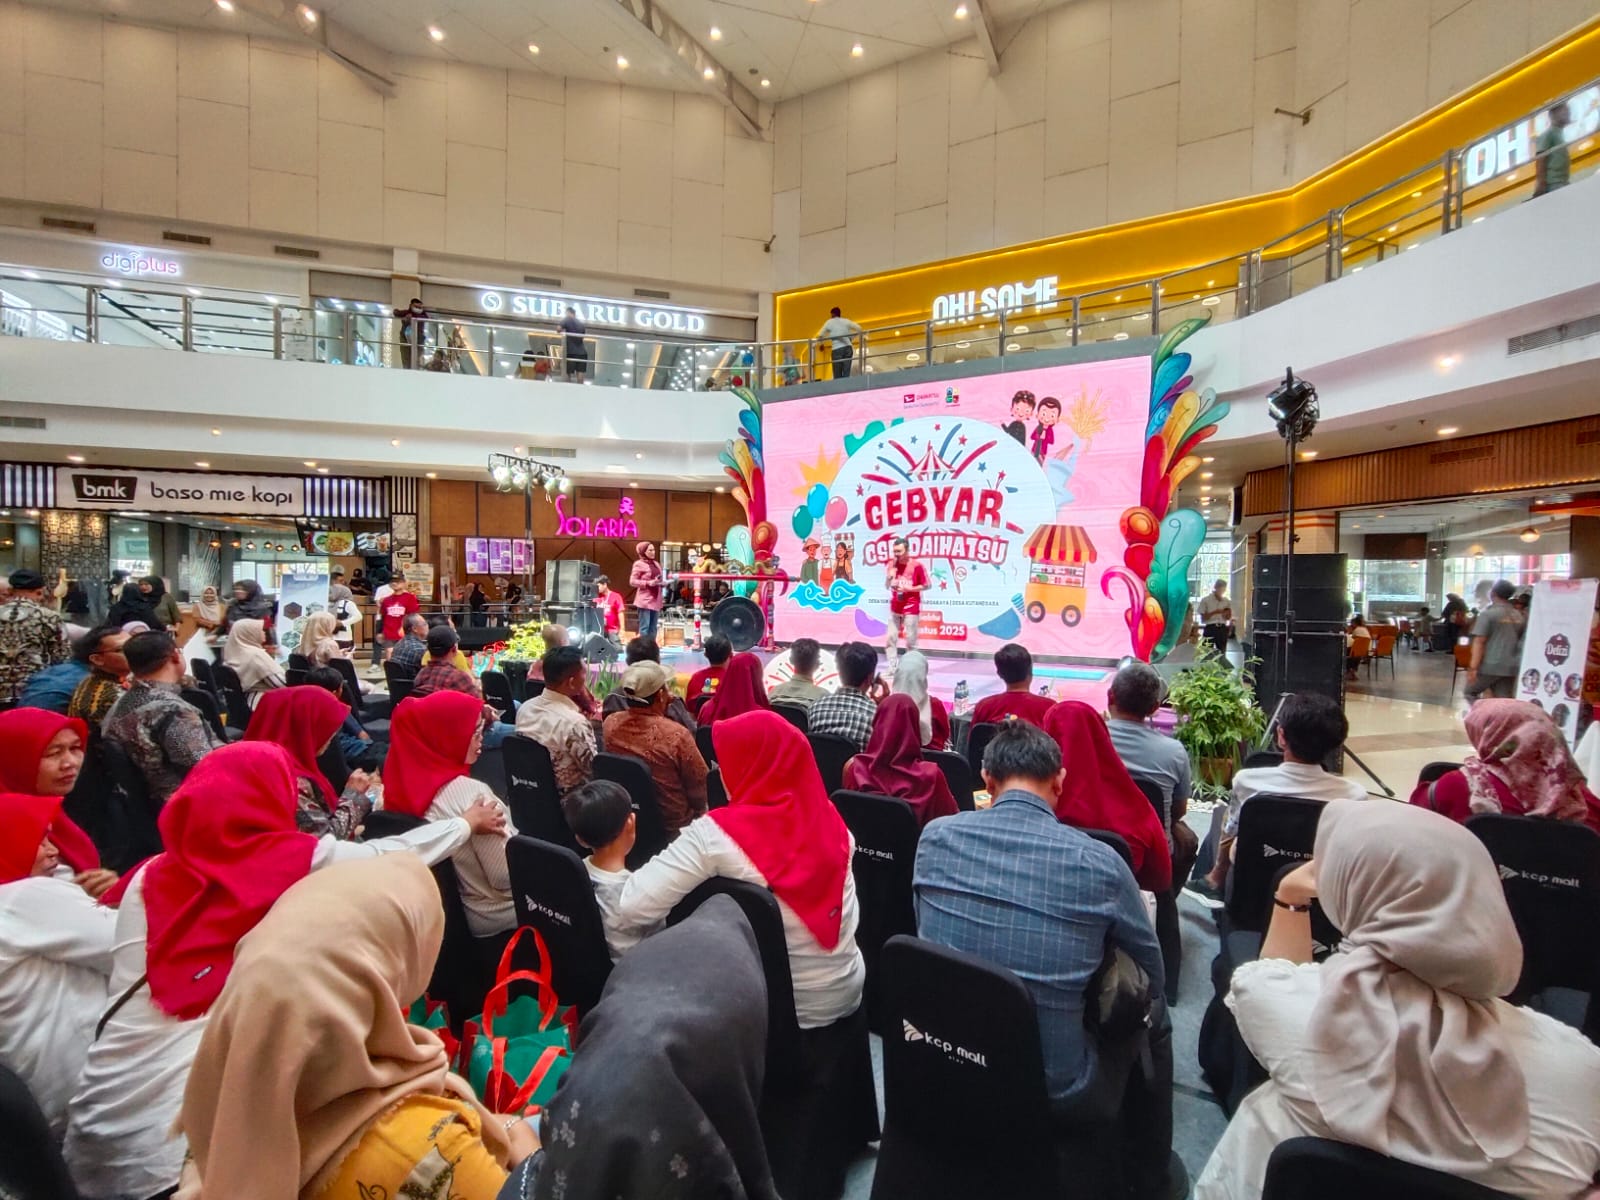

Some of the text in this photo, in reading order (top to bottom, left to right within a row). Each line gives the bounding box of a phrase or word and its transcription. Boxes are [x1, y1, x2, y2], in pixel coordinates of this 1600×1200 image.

[102, 251, 177, 273] digiplus
[933, 276, 1058, 324] OH! SOME
[512, 296, 627, 324] SUBARU
[634, 309, 705, 332] GOLD
[83, 478, 127, 498] bmk
[151, 481, 293, 507] baso mie kopi
[864, 486, 1004, 530] GEBYAR
[908, 534, 1008, 564] DAIHATSU
[939, 625, 966, 636] 2025
[858, 845, 875, 856] kcp
[1280, 849, 1301, 858] kcp
[1521, 870, 1549, 882] kcp
[1551, 876, 1580, 888] mall
[924, 1031, 953, 1053] kcp
[956, 1046, 988, 1068] mall
